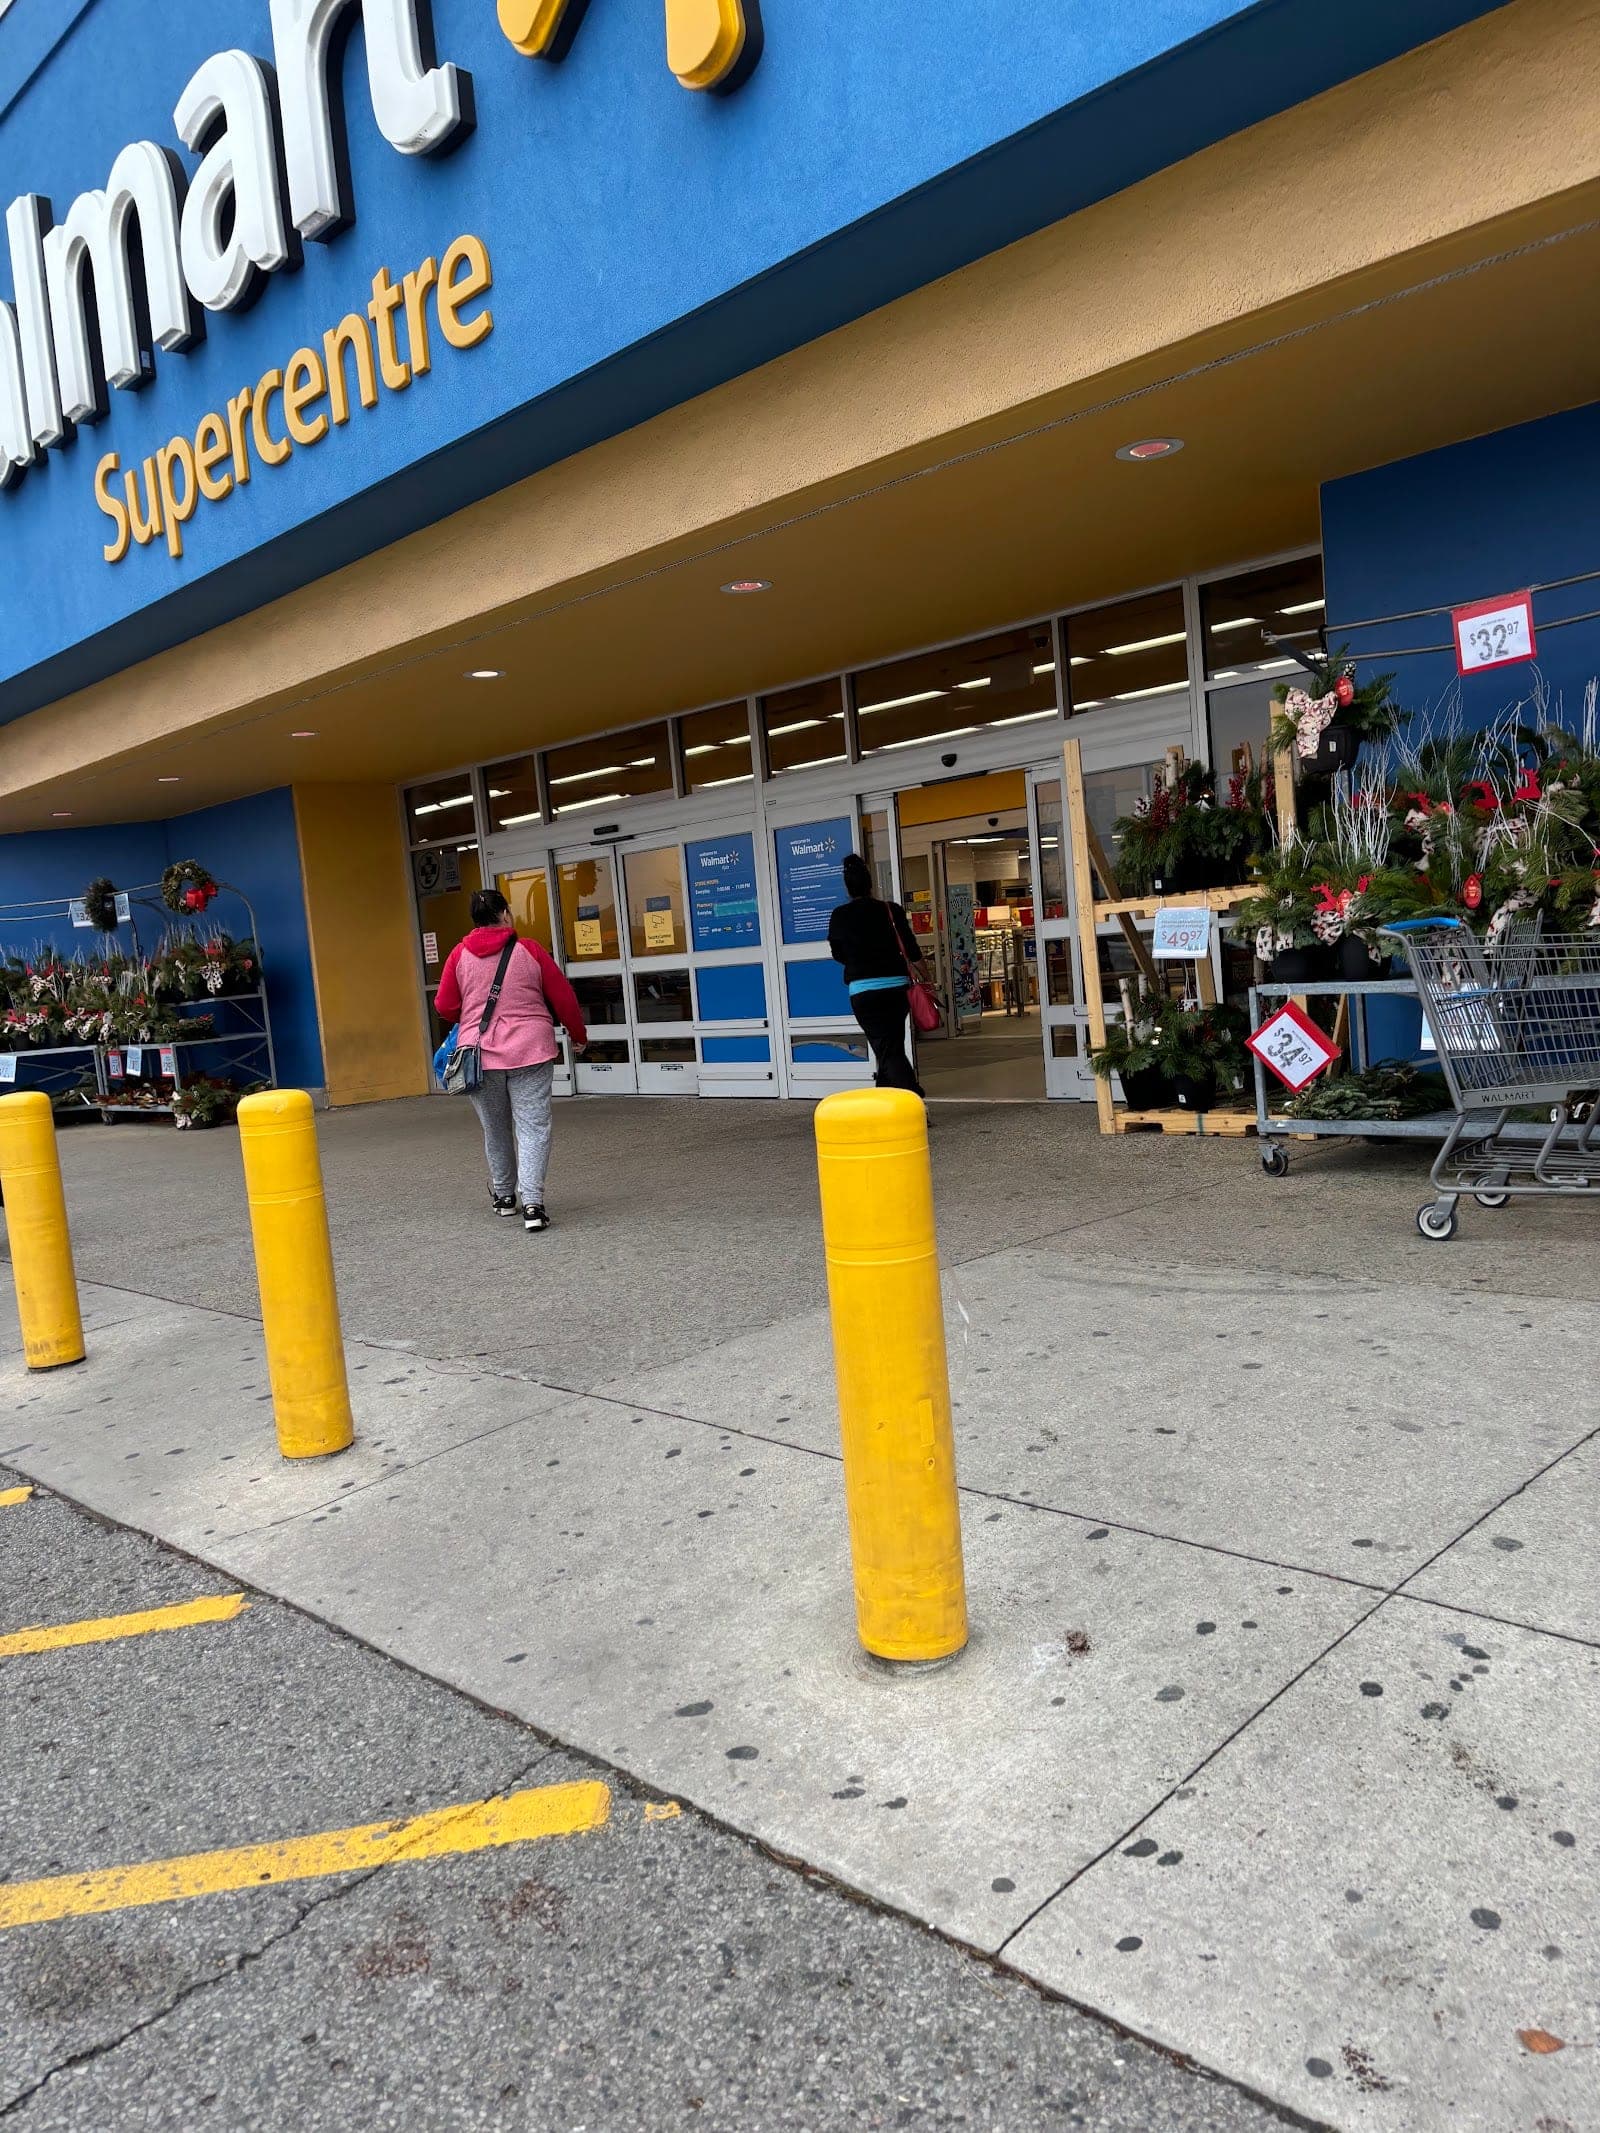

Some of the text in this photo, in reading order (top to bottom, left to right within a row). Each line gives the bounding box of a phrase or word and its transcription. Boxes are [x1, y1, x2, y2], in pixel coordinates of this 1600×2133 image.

[95, 234, 493, 562] Supercentre
[791, 842, 825, 856] Walmart
[700, 854, 730, 868] Walmart
[1481, 1090, 1536, 1103] WALMART
